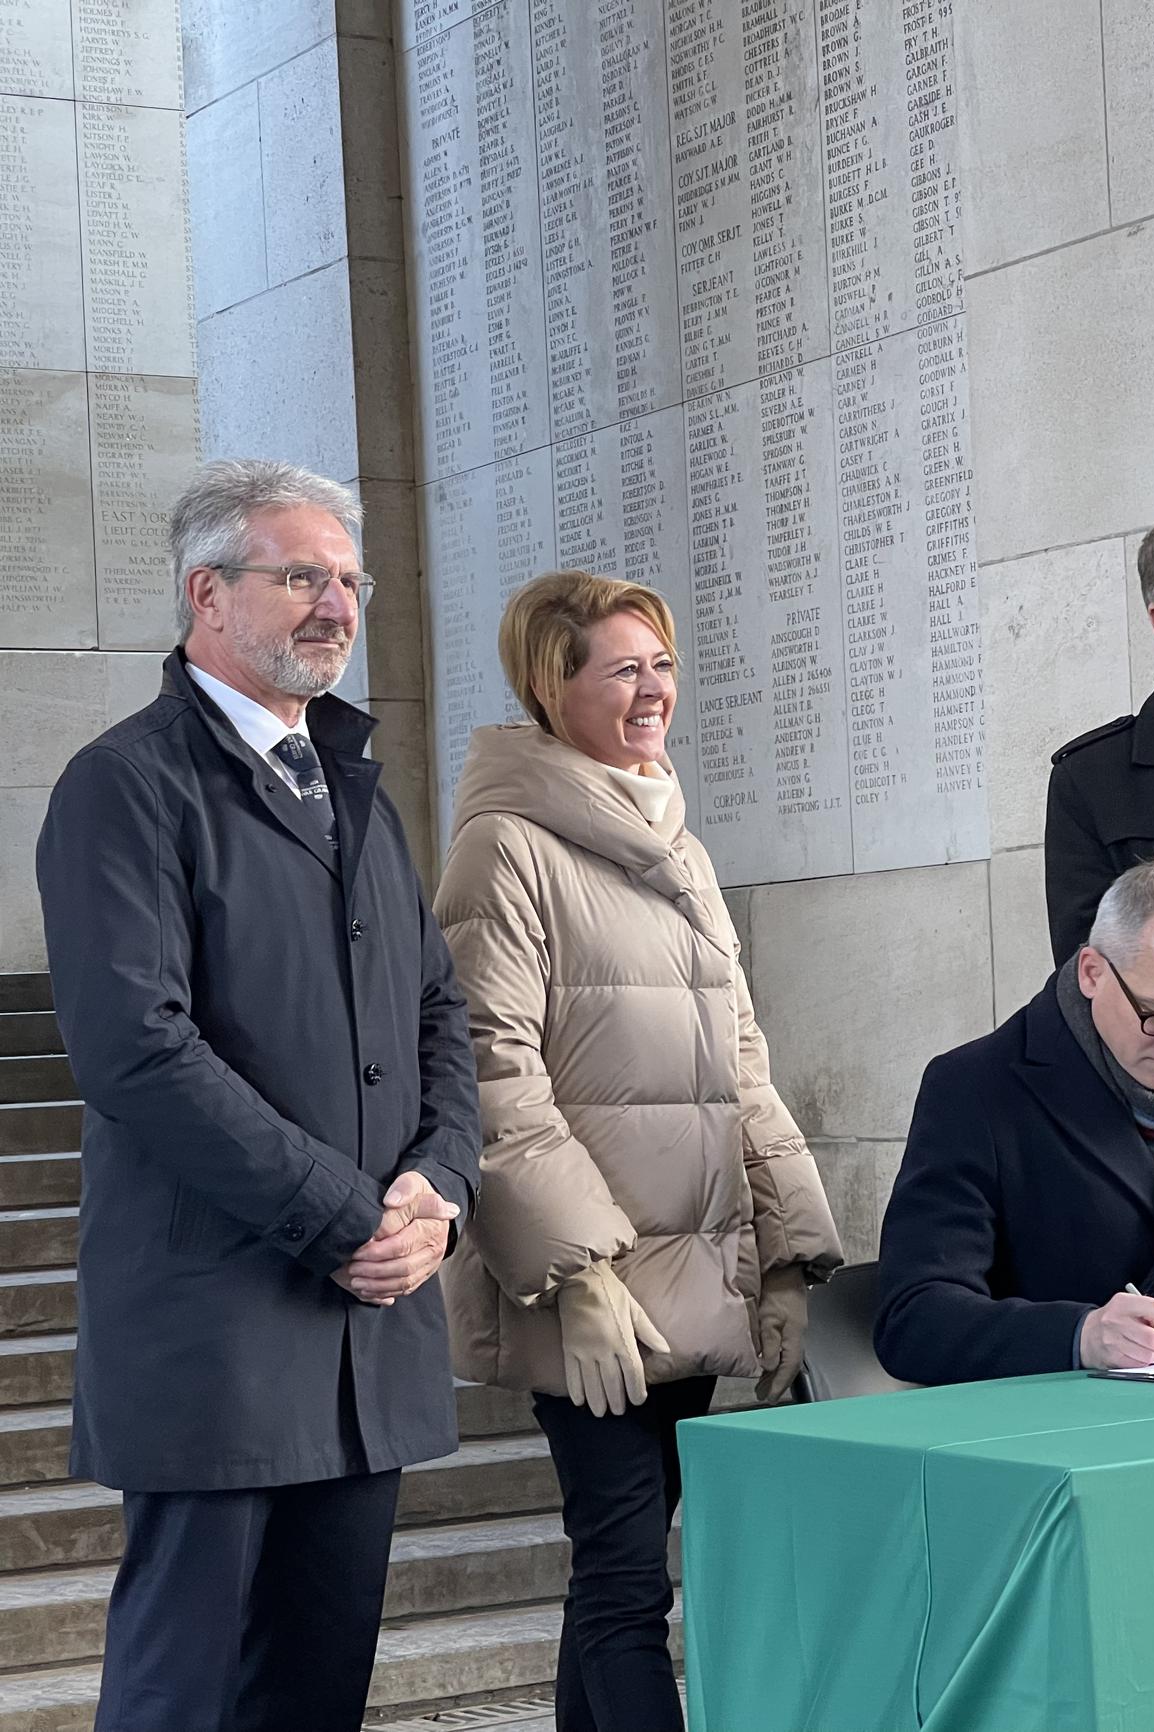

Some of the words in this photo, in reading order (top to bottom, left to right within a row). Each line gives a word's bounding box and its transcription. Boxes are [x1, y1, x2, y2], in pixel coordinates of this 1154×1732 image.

[820, 4, 850, 26] BROOME
[821, 21, 848, 41] BROWN
[822, 36, 849, 57] BROWN
[904, 35, 918, 50] FRY
[905, 38, 948, 65] GALBRAITH
[824, 80, 850, 101] BROWN
[907, 75, 938, 96] GARNER
[907, 89, 940, 111] GARSIDE
[908, 109, 930, 127] GASH
[826, 120, 866, 146] BUCHANAN
[911, 183, 938, 203] GIBSON
[692, 270, 733, 296] SERJEANT
[924, 488, 960, 506] GREGORY
[101, 510, 136, 522] EAST
[140, 527, 170, 537] COLO
[129, 556, 167, 566] MAJOR
[928, 564, 966, 582] HACKNEY
[846, 585, 874, 600] CLARKE
[928, 580, 966, 597] HALFORD
[929, 598, 951, 612] HALL
[786, 607, 820, 626] PRIVATE
[850, 658, 883, 673] CLAYTON
[700, 697, 723, 713] LANCE
[725, 690, 763, 709] SERJEANT
[773, 688, 796, 701] ALLEN
[852, 717, 884, 731] CLINTON
[934, 716, 974, 733] HAMPSON
[935, 732, 973, 749] HANDLEY
[936, 748, 971, 764] HANTON
[714, 790, 758, 809] CORPORAL
[855, 792, 880, 805] COLEY
